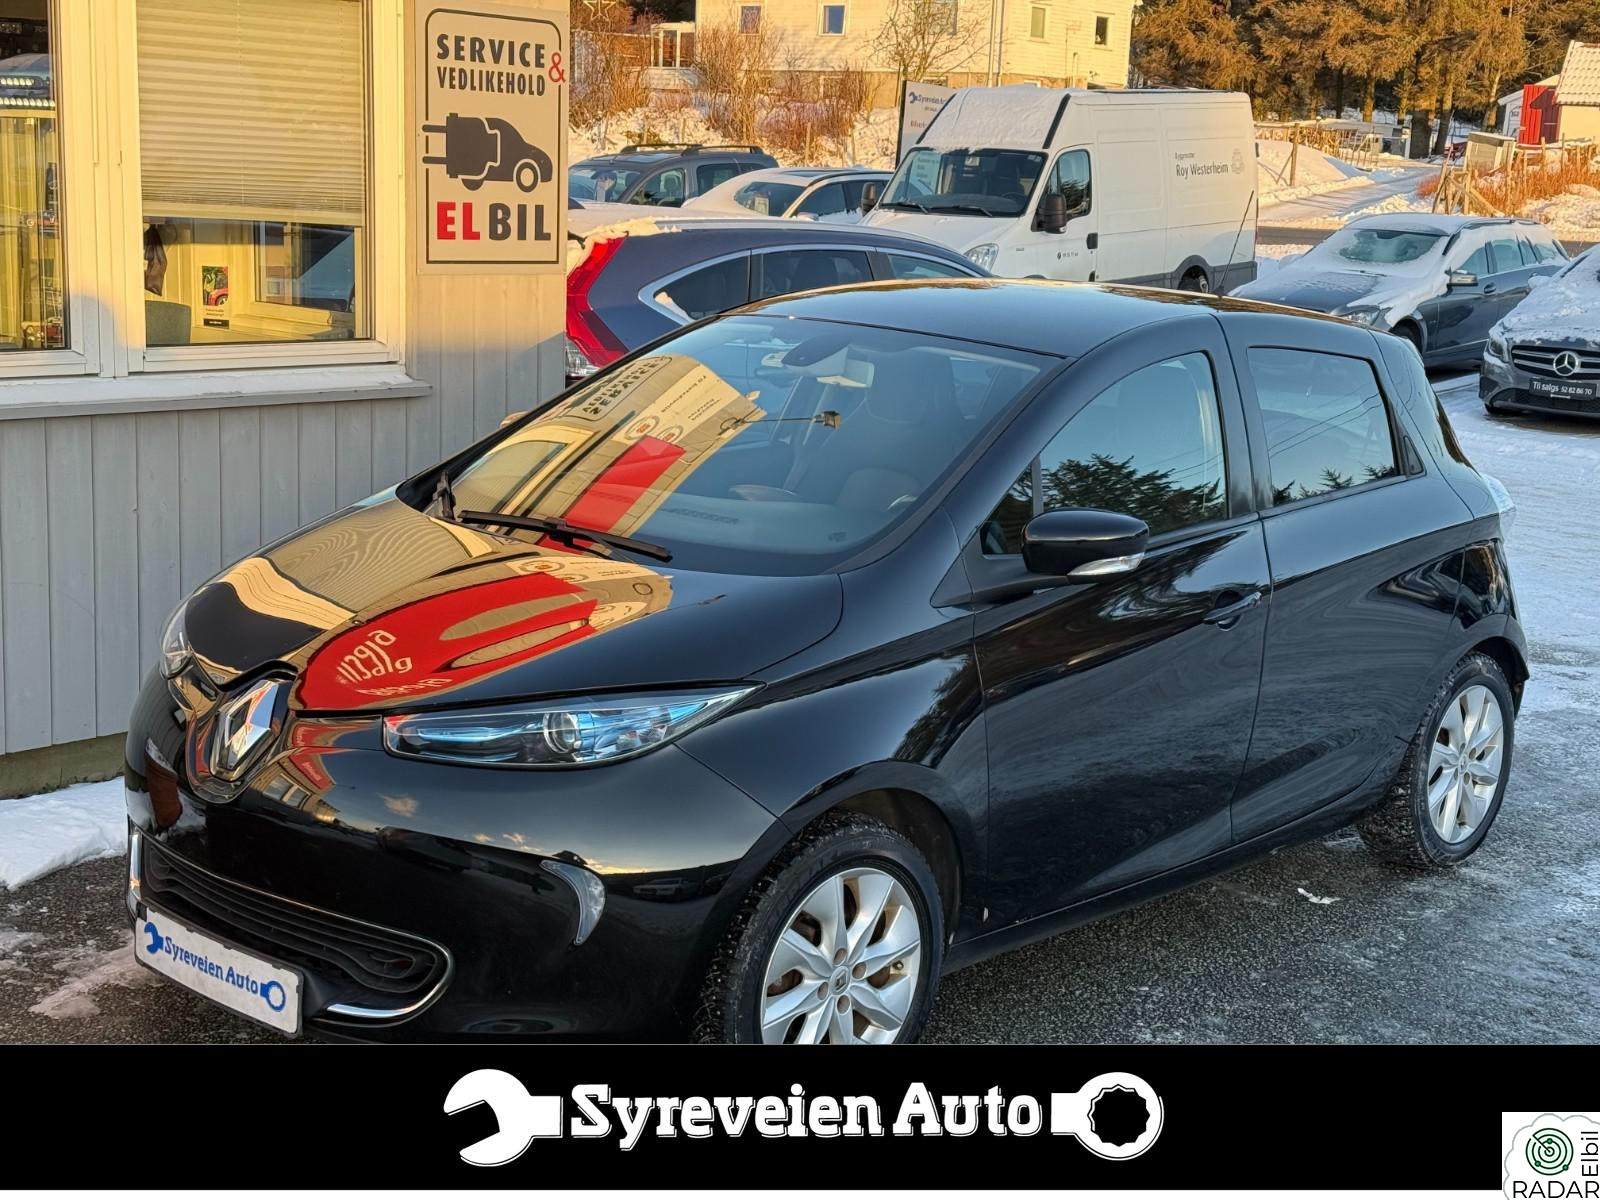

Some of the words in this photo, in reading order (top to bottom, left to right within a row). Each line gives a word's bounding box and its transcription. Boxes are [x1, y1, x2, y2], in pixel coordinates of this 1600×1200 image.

[437, 34, 545, 68] SERVICE
[548, 52, 565, 83] &
[437, 67, 545, 96] VEDLIKEHOLD
[1176, 164, 1189, 180] Roy
[1190, 161, 1229, 175] Westerheim
[1533, 381, 1541, 390] Til
[1541, 383, 1559, 393] salgs
[164, 936, 225, 984] Syreveien
[224, 966, 259, 995] Auto
